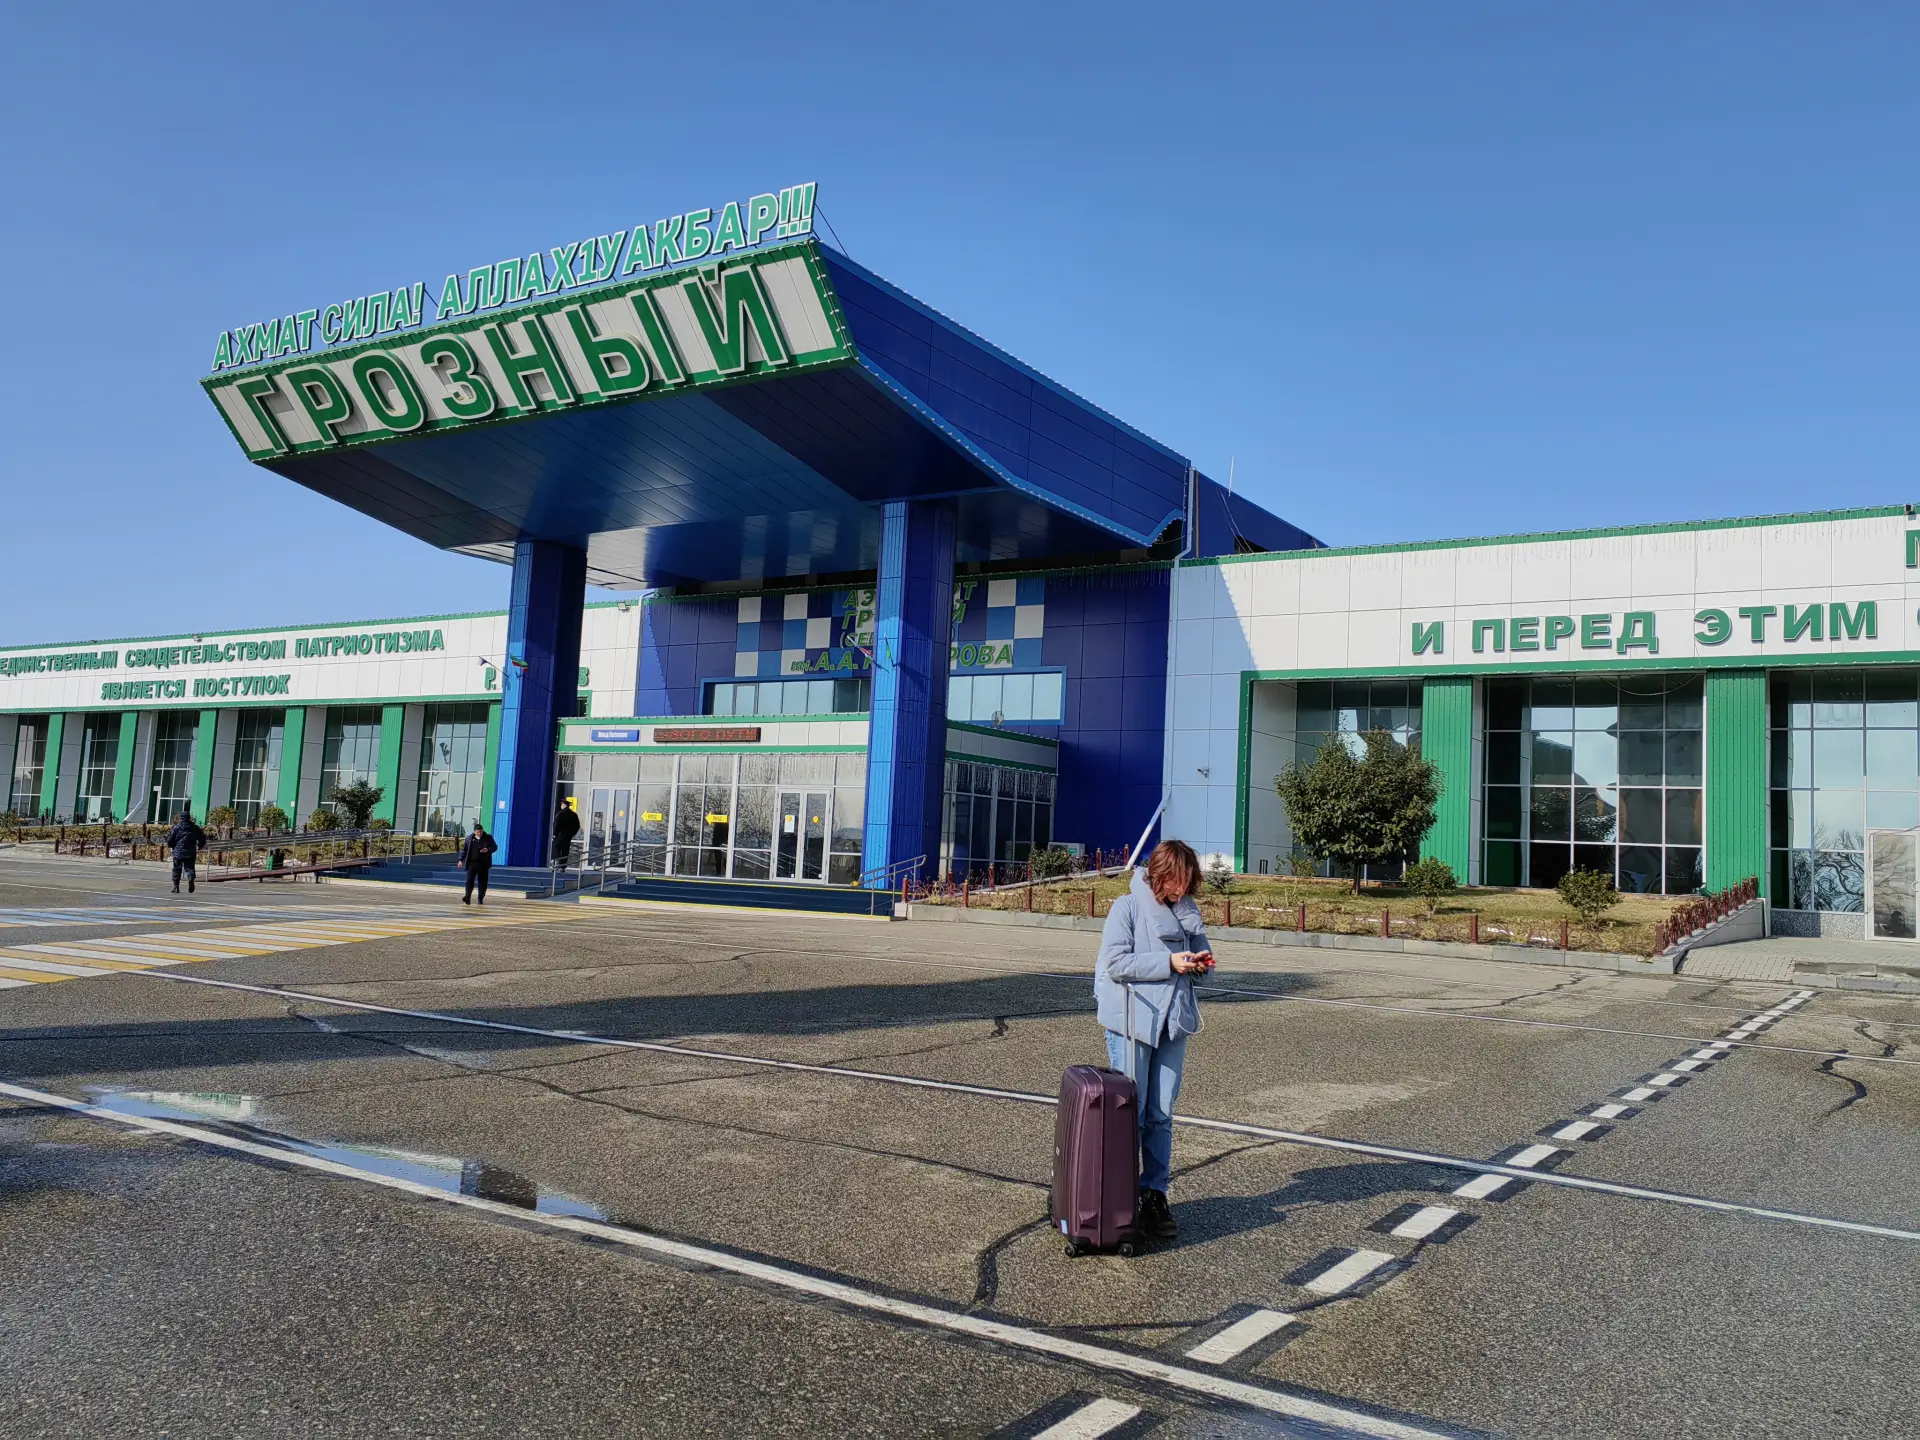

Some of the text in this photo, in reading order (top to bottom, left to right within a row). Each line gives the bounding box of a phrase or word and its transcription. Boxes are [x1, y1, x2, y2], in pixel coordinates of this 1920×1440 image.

[212, 181, 818, 371] АХМАТ СИЛА! АЛЛАХ1УАКБАР!!!
[233, 262, 789, 454] ГРОЗНЫЙ
[124, 639, 286, 669] СВИДЕТЕЛЬСТВОМ
[294, 629, 445, 658] ПАТРИОТИЗМА
[1411, 621, 1444, 654] И
[1471, 611, 1659, 654] ПЕРЕД
[1693, 600, 1878, 645] ЭТИМ
[100, 673, 291, 700] ЯВЛЯЕТСЯ ПОСТУПОК
